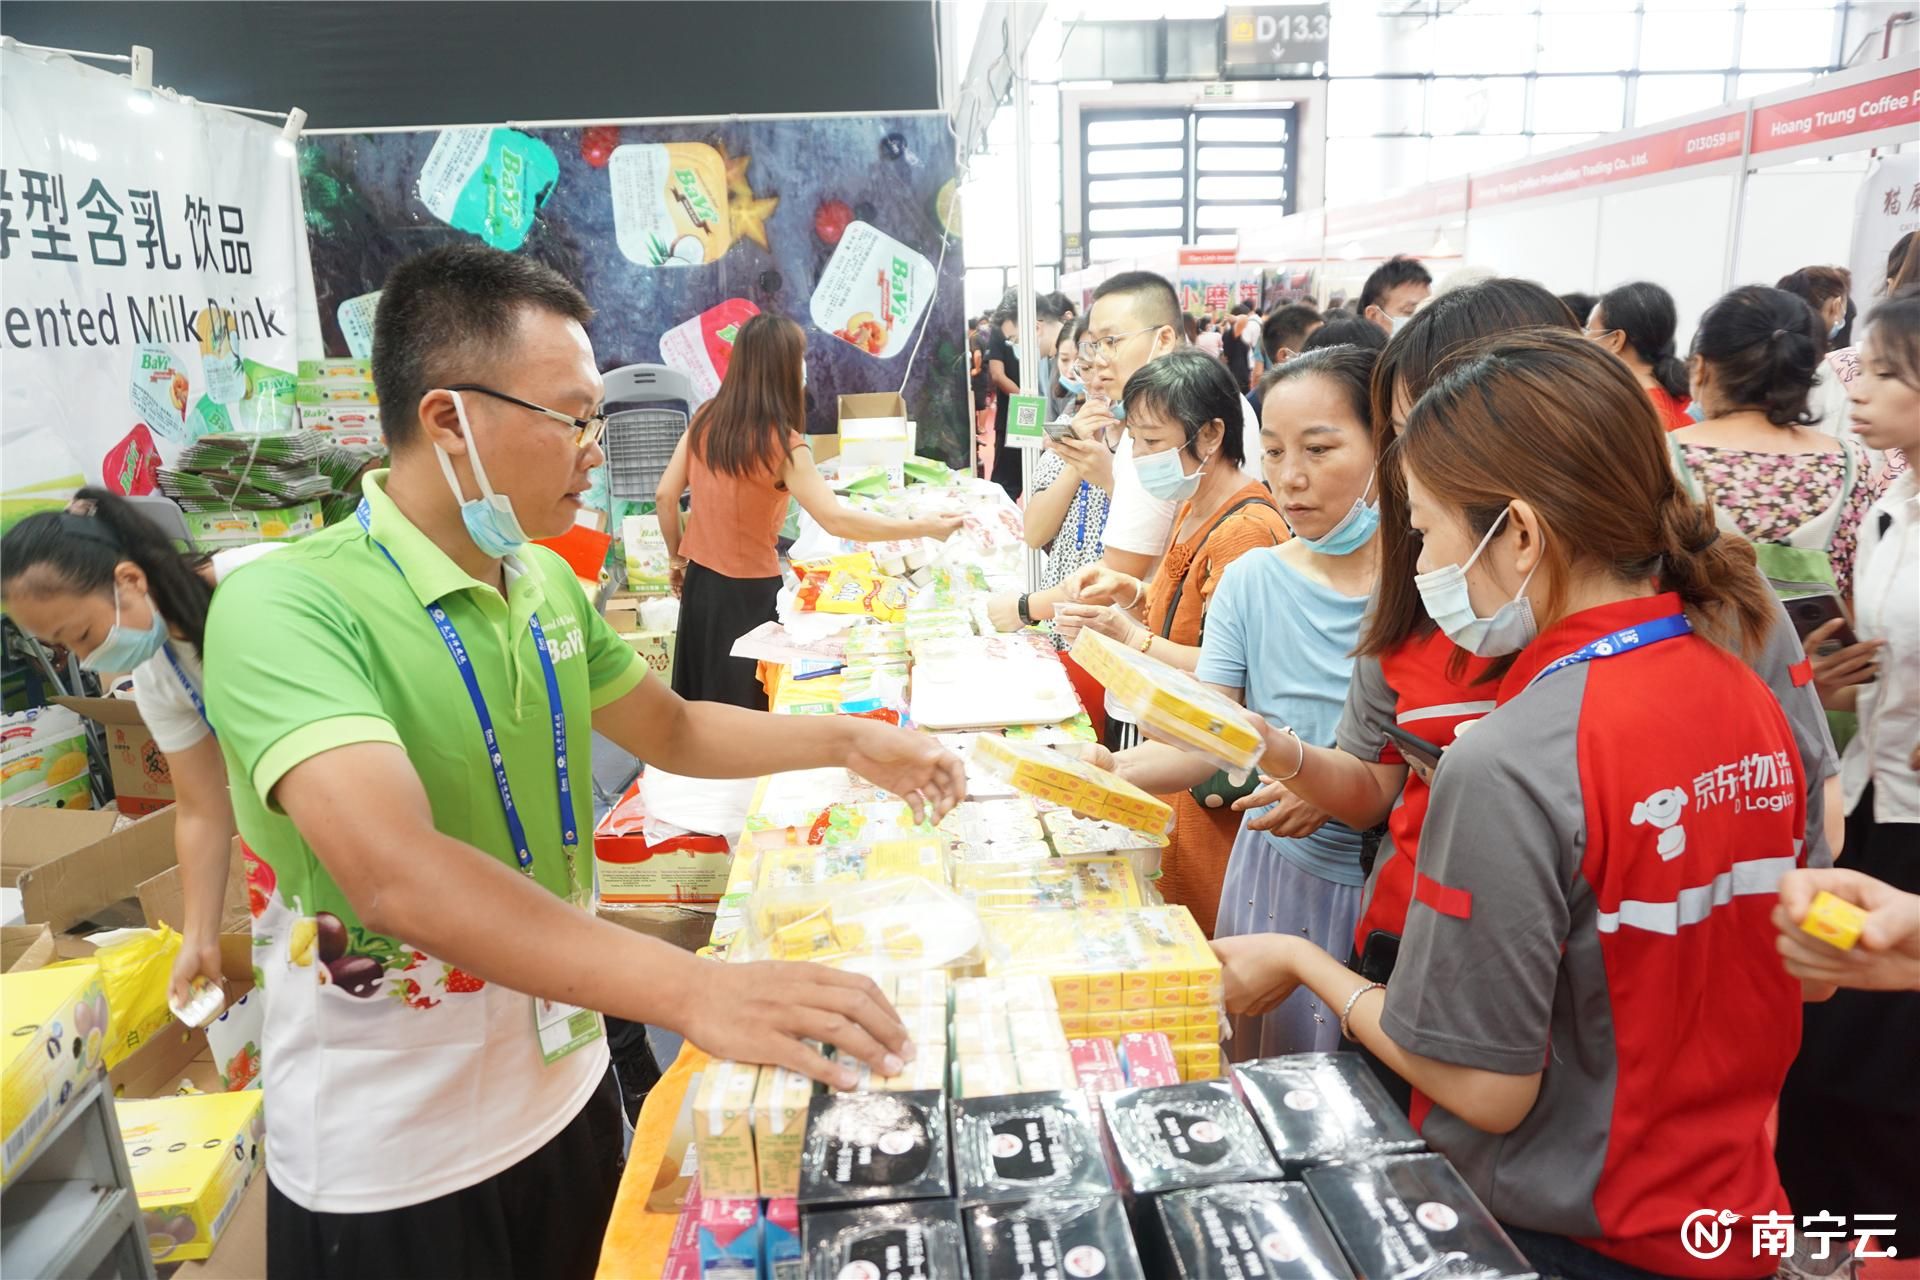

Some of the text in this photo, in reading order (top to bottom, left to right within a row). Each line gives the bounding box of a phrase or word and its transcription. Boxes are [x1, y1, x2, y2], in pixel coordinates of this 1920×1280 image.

[1256, 15, 1329, 41] D13.3
[1770, 116, 1812, 136] Hoang
[1815, 106, 1856, 127] Trung
[1859, 93, 1908, 117] Coffee
[1686, 131, 1727, 153] D13059
[1582, 161, 1613, 177] Trading
[1614, 157, 1631, 171] Co.,
[1632, 151, 1649, 167] Ltd.
[502, 144, 522, 227] BaVi
[674, 168, 715, 222] BaVi
[890, 255, 909, 320] BaVi
[127, 294, 203, 344] Milk
[207, 296, 287, 342] Drink
[141, 353, 172, 372] BaVi
[258, 376, 291, 394] BaVi
[119, 439, 140, 496] BaVi
[547, 627, 584, 665] BaVi
